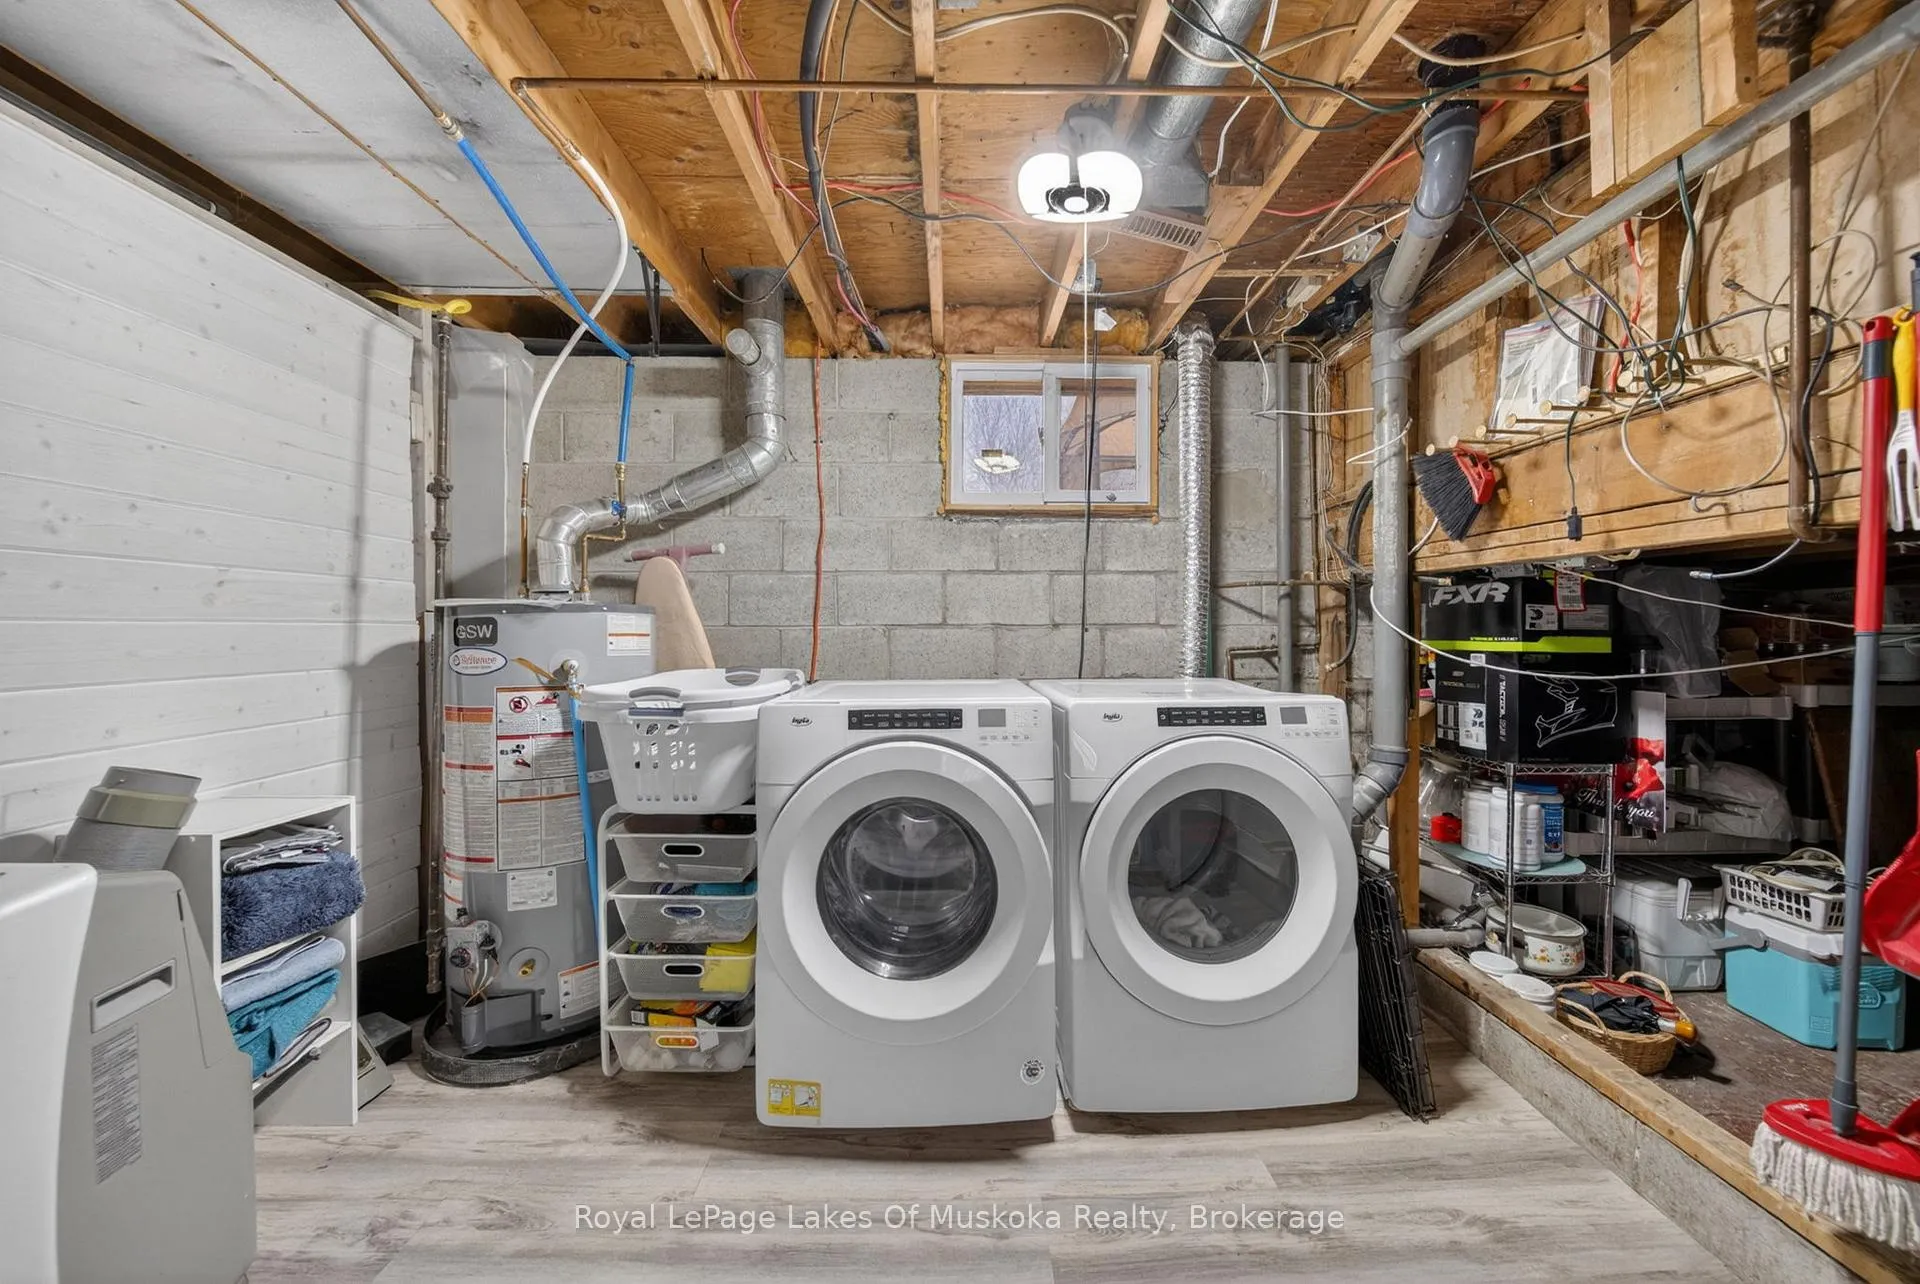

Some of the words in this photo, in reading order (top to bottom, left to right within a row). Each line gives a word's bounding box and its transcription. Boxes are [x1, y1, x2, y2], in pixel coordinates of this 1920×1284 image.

[1430, 582, 1510, 605] FXR
[456, 624, 493, 639] GSW
[1626, 803, 1655, 820] you
